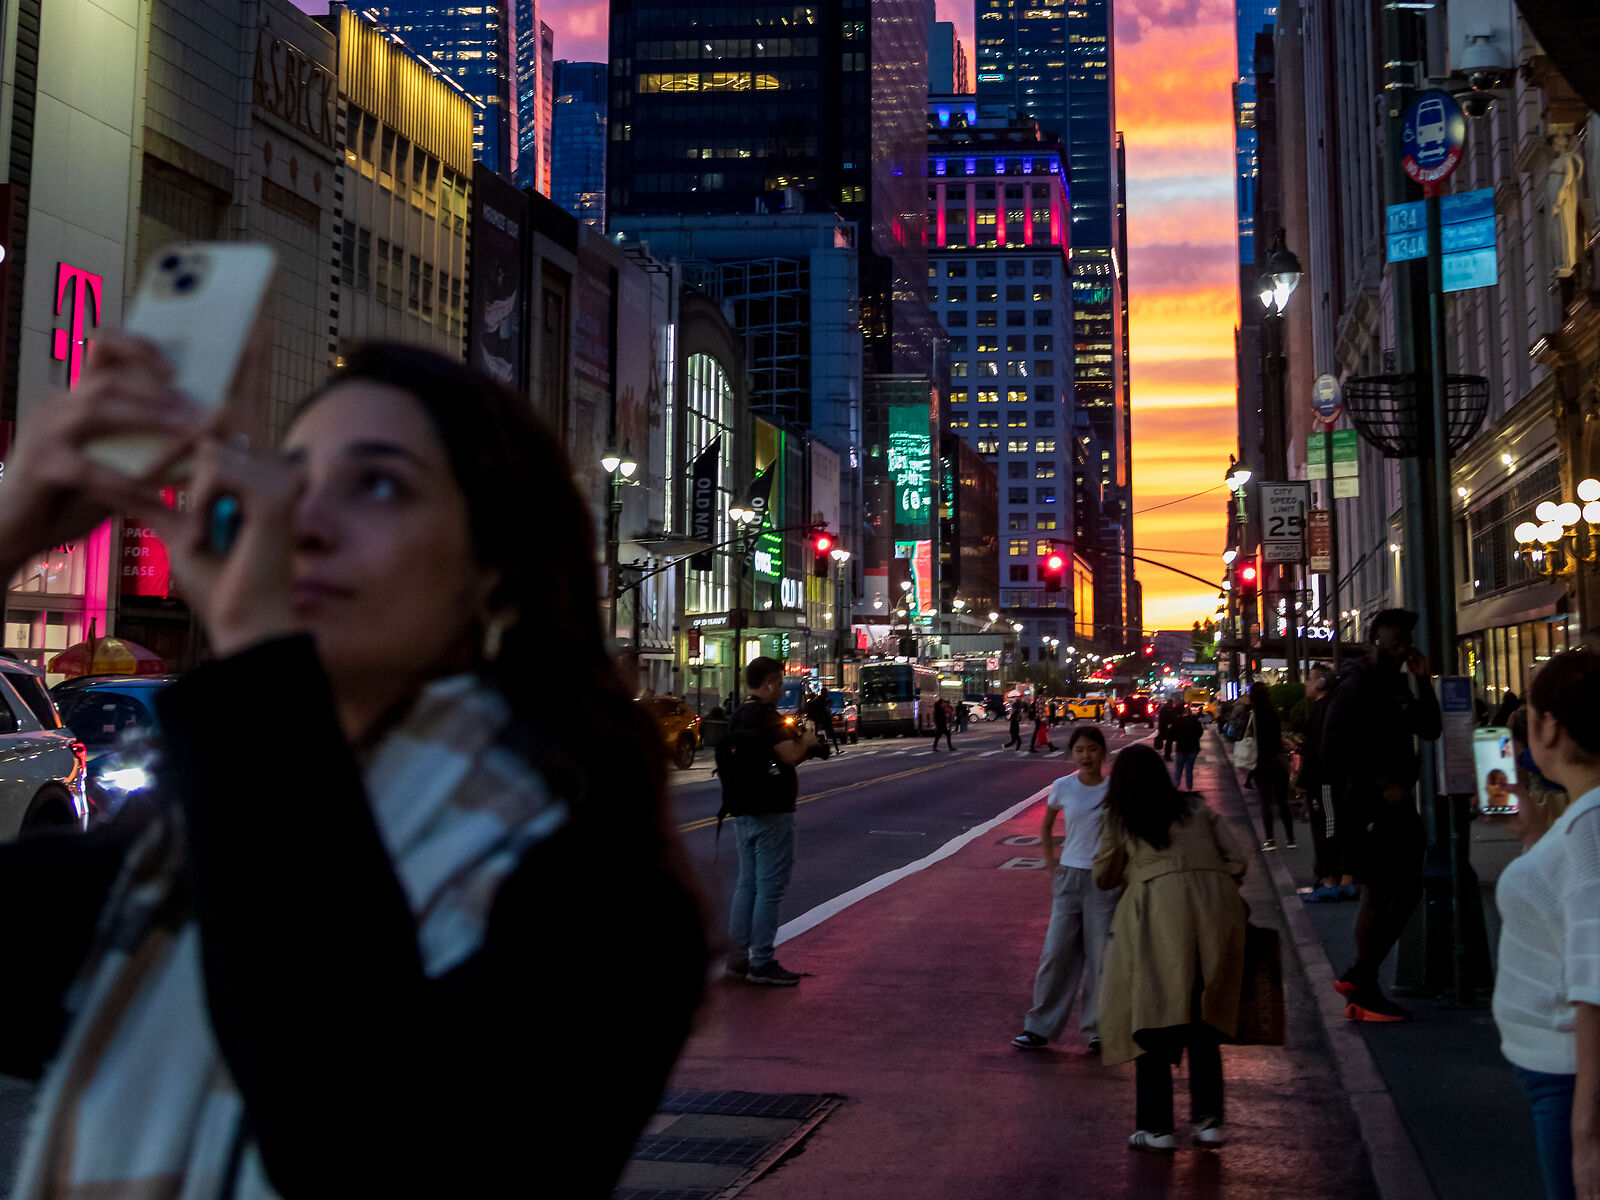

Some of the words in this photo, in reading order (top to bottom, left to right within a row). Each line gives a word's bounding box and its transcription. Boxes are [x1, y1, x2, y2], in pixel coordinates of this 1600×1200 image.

[1407, 160, 1418, 176] NO
[1418, 153, 1457, 181] STANDING
[1389, 208, 1417, 232] M34
[1390, 236, 1425, 259] M34A
[52, 262, 103, 392] T
[696, 477, 712, 509] OLD
[1270, 497, 1297, 505] SPEED
[1273, 488, 1293, 496] CITY
[1273, 505, 1295, 513] LIMIT
[1268, 516, 1300, 537] 25
[124, 546, 150, 557] FOR
[123, 564, 155, 577] EASE
